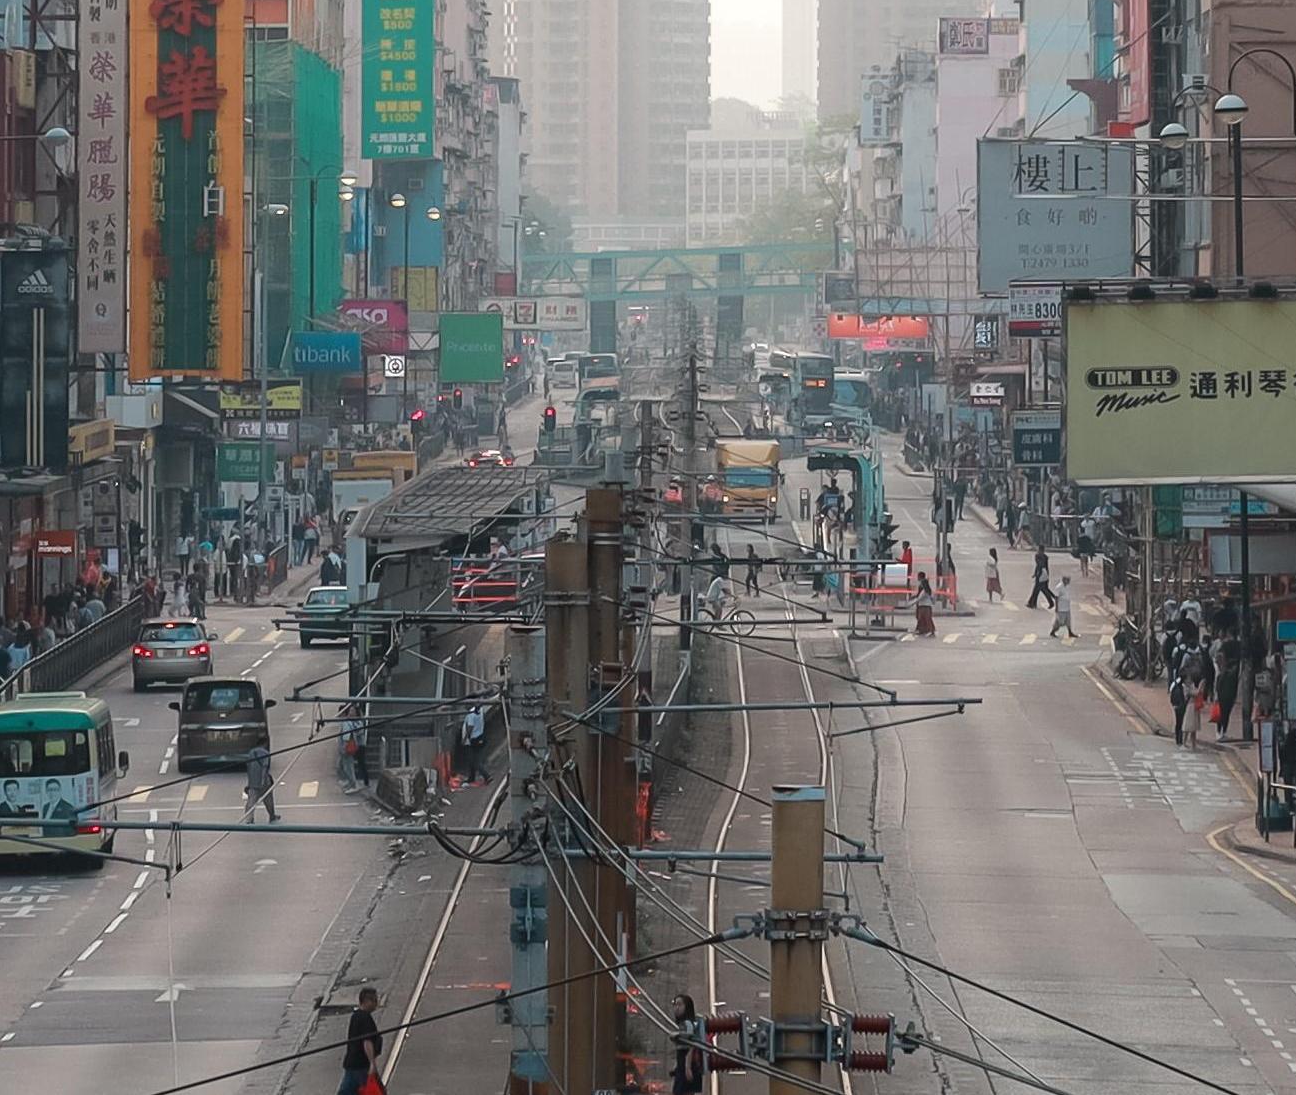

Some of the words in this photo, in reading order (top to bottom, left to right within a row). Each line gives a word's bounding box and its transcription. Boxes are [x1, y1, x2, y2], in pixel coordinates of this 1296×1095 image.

[1013, 154, 1097, 194] 樓上
[17, 285, 54, 293] adidas
[1095, 370, 1132, 386] TOM
[1141, 369, 1172, 385] LEE
[1095, 388, 1180, 417] Music
